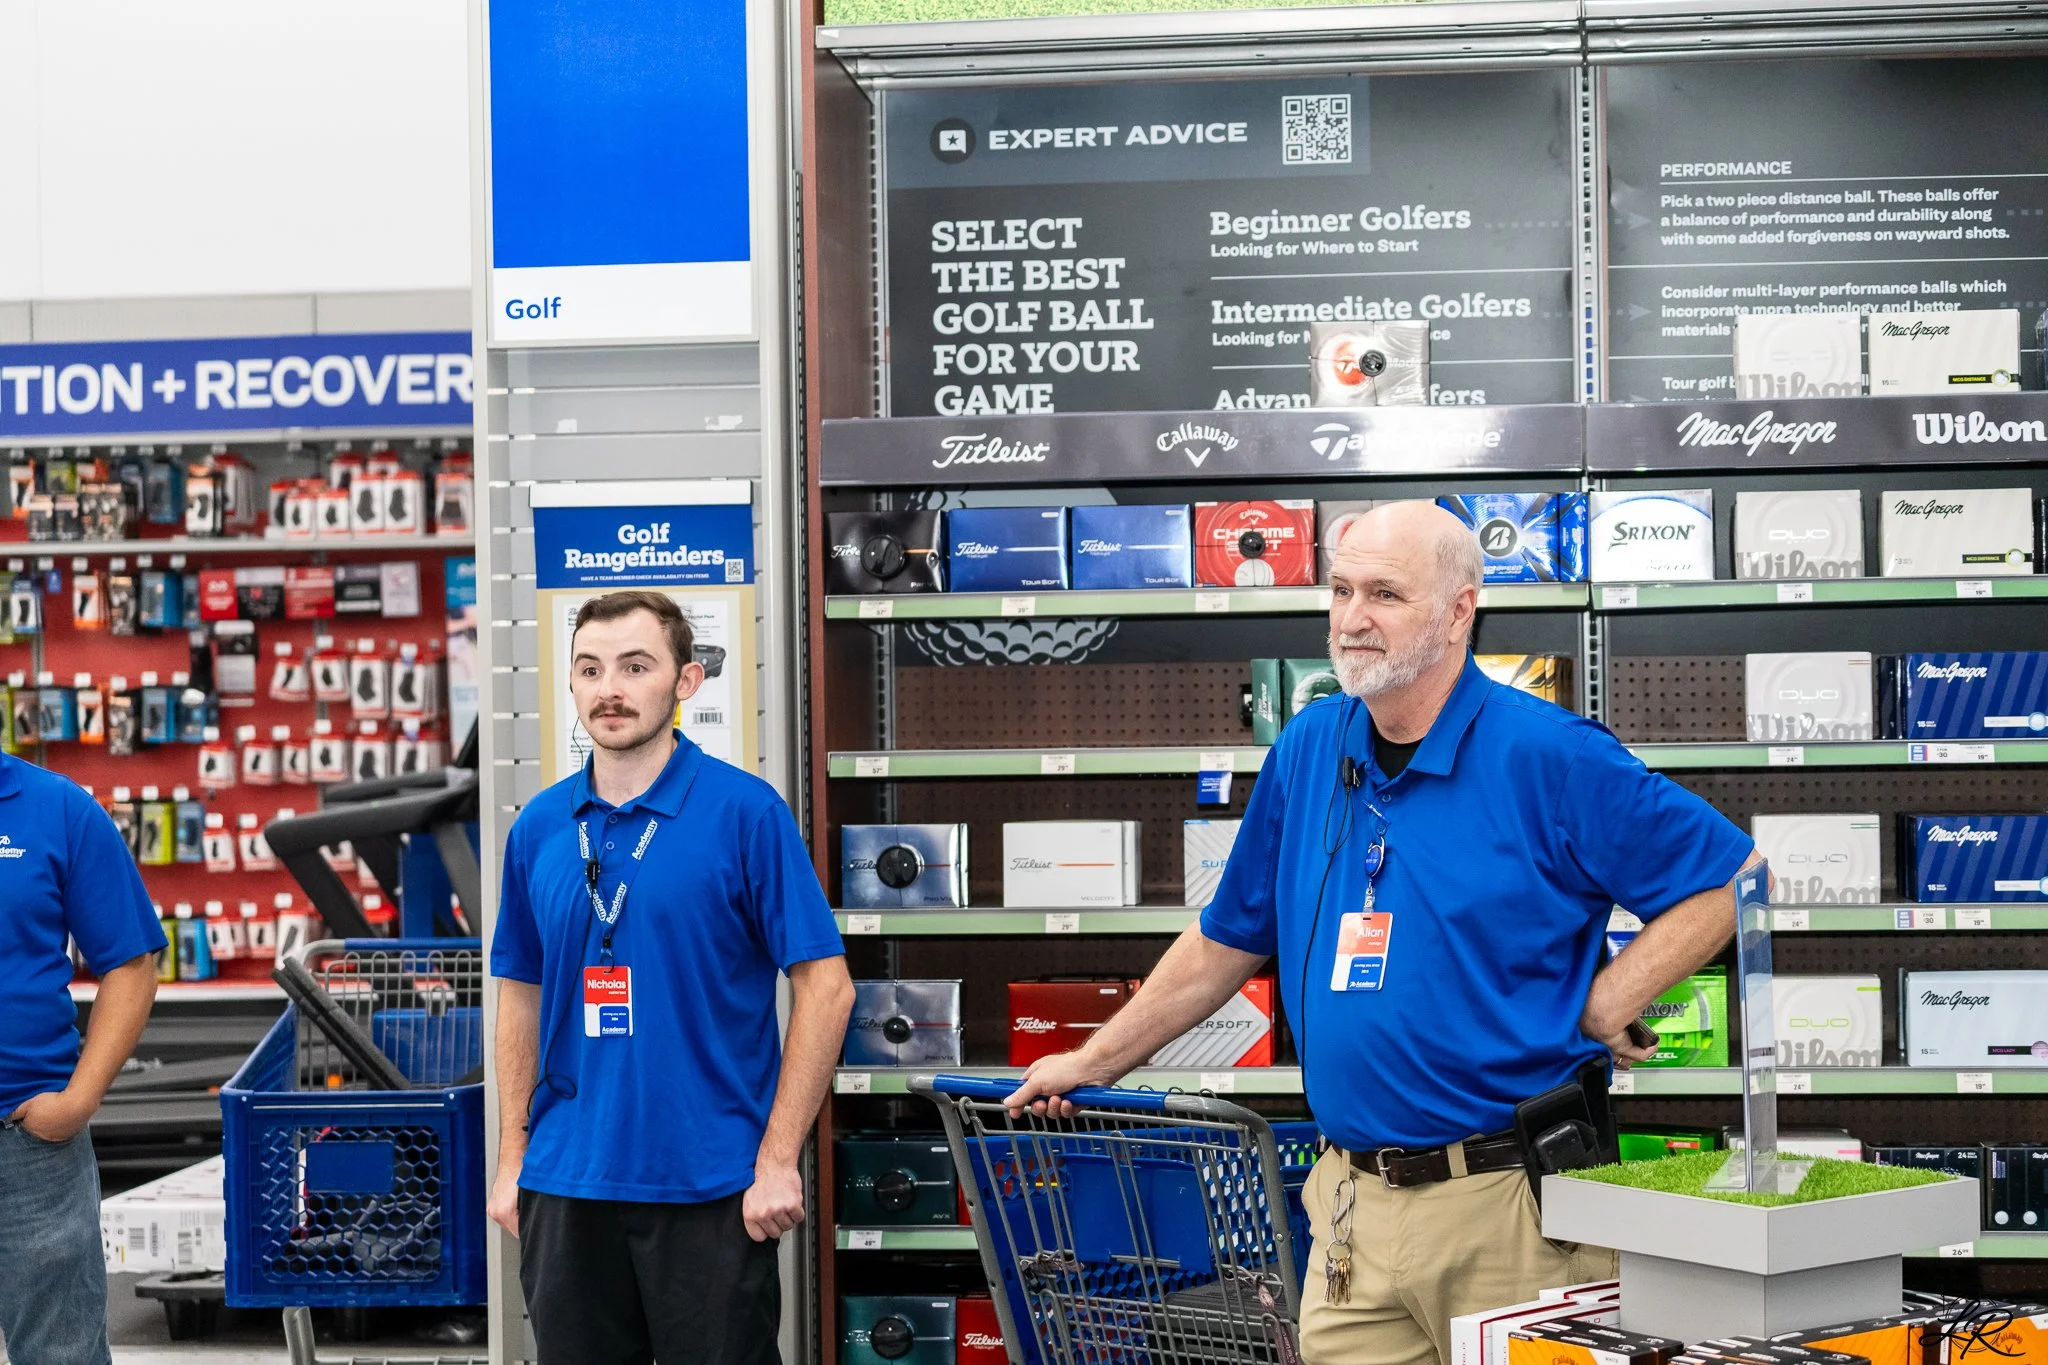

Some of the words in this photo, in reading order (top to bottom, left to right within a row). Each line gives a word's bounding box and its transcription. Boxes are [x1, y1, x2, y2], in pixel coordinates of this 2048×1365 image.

[988, 125, 1118, 150] EXPERT
[1125, 122, 1248, 146] ADVICE
[1660, 161, 1792, 177] PERFORMANCE
[1661, 195, 1692, 207] Pick
[1695, 198, 1704, 207] a
[1706, 196, 1735, 206] two
[1737, 194, 1777, 208] piece
[1779, 192, 1842, 206] distance
[1844, 190, 1875, 203] ball.
[1877, 189, 1923, 203] These
[1925, 188, 1960, 201] balls
[1963, 187, 1999, 201] offer
[1210, 209, 1353, 241] Beginner
[1360, 205, 1472, 232] Golfers
[1660, 216, 1670, 226] a
[1672, 213, 1729, 226] balance
[1732, 212, 1748, 225] of
[1750, 211, 1845, 227] performance
[1847, 209, 1875, 222] and
[1877, 208, 1949, 223] durability
[1951, 207, 1993, 223] along
[931, 217, 1082, 252] SELECT
[1661, 232, 1694, 245] with
[1697, 234, 1736, 245] some
[1739, 230, 1784, 244] added
[1787, 229, 1871, 245] forgiveness
[1874, 230, 1893, 241] on
[1895, 227, 1963, 243] wayward
[1965, 226, 2010, 240] shots.
[1211, 243, 1274, 259] Looking
[1275, 241, 1300, 256] for
[1302, 240, 1354, 256] Where
[1357, 240, 1375, 254] to
[1377, 239, 1419, 253] Start
[931, 261, 1014, 293] THE
[1022, 258, 1126, 291] BEST
[1661, 285, 1729, 299] Consider
[1732, 283, 1816, 298] multi-layer
[1819, 281, 1918, 298] performance
[1921, 280, 1958, 294] balls
[1959, 279, 2007, 293] which
[505, 297, 562, 319] Golf
[933, 301, 1041, 334] GOLF
[1049, 298, 1154, 332] BALL
[1211, 296, 1412, 325] Intermediate
[1419, 292, 1531, 320] Golfers
[1662, 303, 1749, 319] incorporate
[1752, 305, 1791, 315] more
[1881, 301, 1908, 313] and
[1910, 300, 1962, 312] better
[1212, 332, 1275, 348] Looking
[1276, 330, 1300, 345] for
[1662, 323, 1731, 337] materials
[1881, 320, 1951, 341] MacGregor
[933, 343, 1016, 375] FOR
[1020, 340, 1140, 373] YOUR
[0, 361, 143, 415] TION
[1662, 377, 1697, 390] Tour
[1699, 375, 1727, 392] golf
[934, 383, 1054, 416] GAME
[1157, 421, 1239, 452] Callaway
[1676, 410, 1837, 457] MacGregor
[1912, 411, 2047, 445] Wilson
[932, 432, 1050, 469] Titleist
[1895, 499, 1964, 519] MacGregor
[617, 522, 670, 545] Golf
[1612, 521, 1691, 541] SRIXON
[1768, 529, 1830, 541] DUO
[955, 541, 999, 556] Titleist
[1078, 539, 1122, 554] Titleist
[564, 545, 724, 572] Rangefinders
[1917, 661, 1988, 683] MacGregor
[1779, 689, 1839, 700] DUO
[632, 818, 656, 860] Academy
[1927, 825, 1998, 847] MacGregor
[1010, 857, 1052, 870] Titleist
[1788, 853, 1848, 864] DUO
[606, 880, 625, 924] Academy
[1357, 927, 1384, 937] Allan
[587, 979, 627, 989] Nicholas
[1921, 990, 1990, 1011] MacGregor
[1013, 1017, 1057, 1031] Titleist
[1789, 1017, 1850, 1028] DUO
[1957, 1151, 1967, 1159] 24
[962, 1332, 1004, 1347] Titleist
